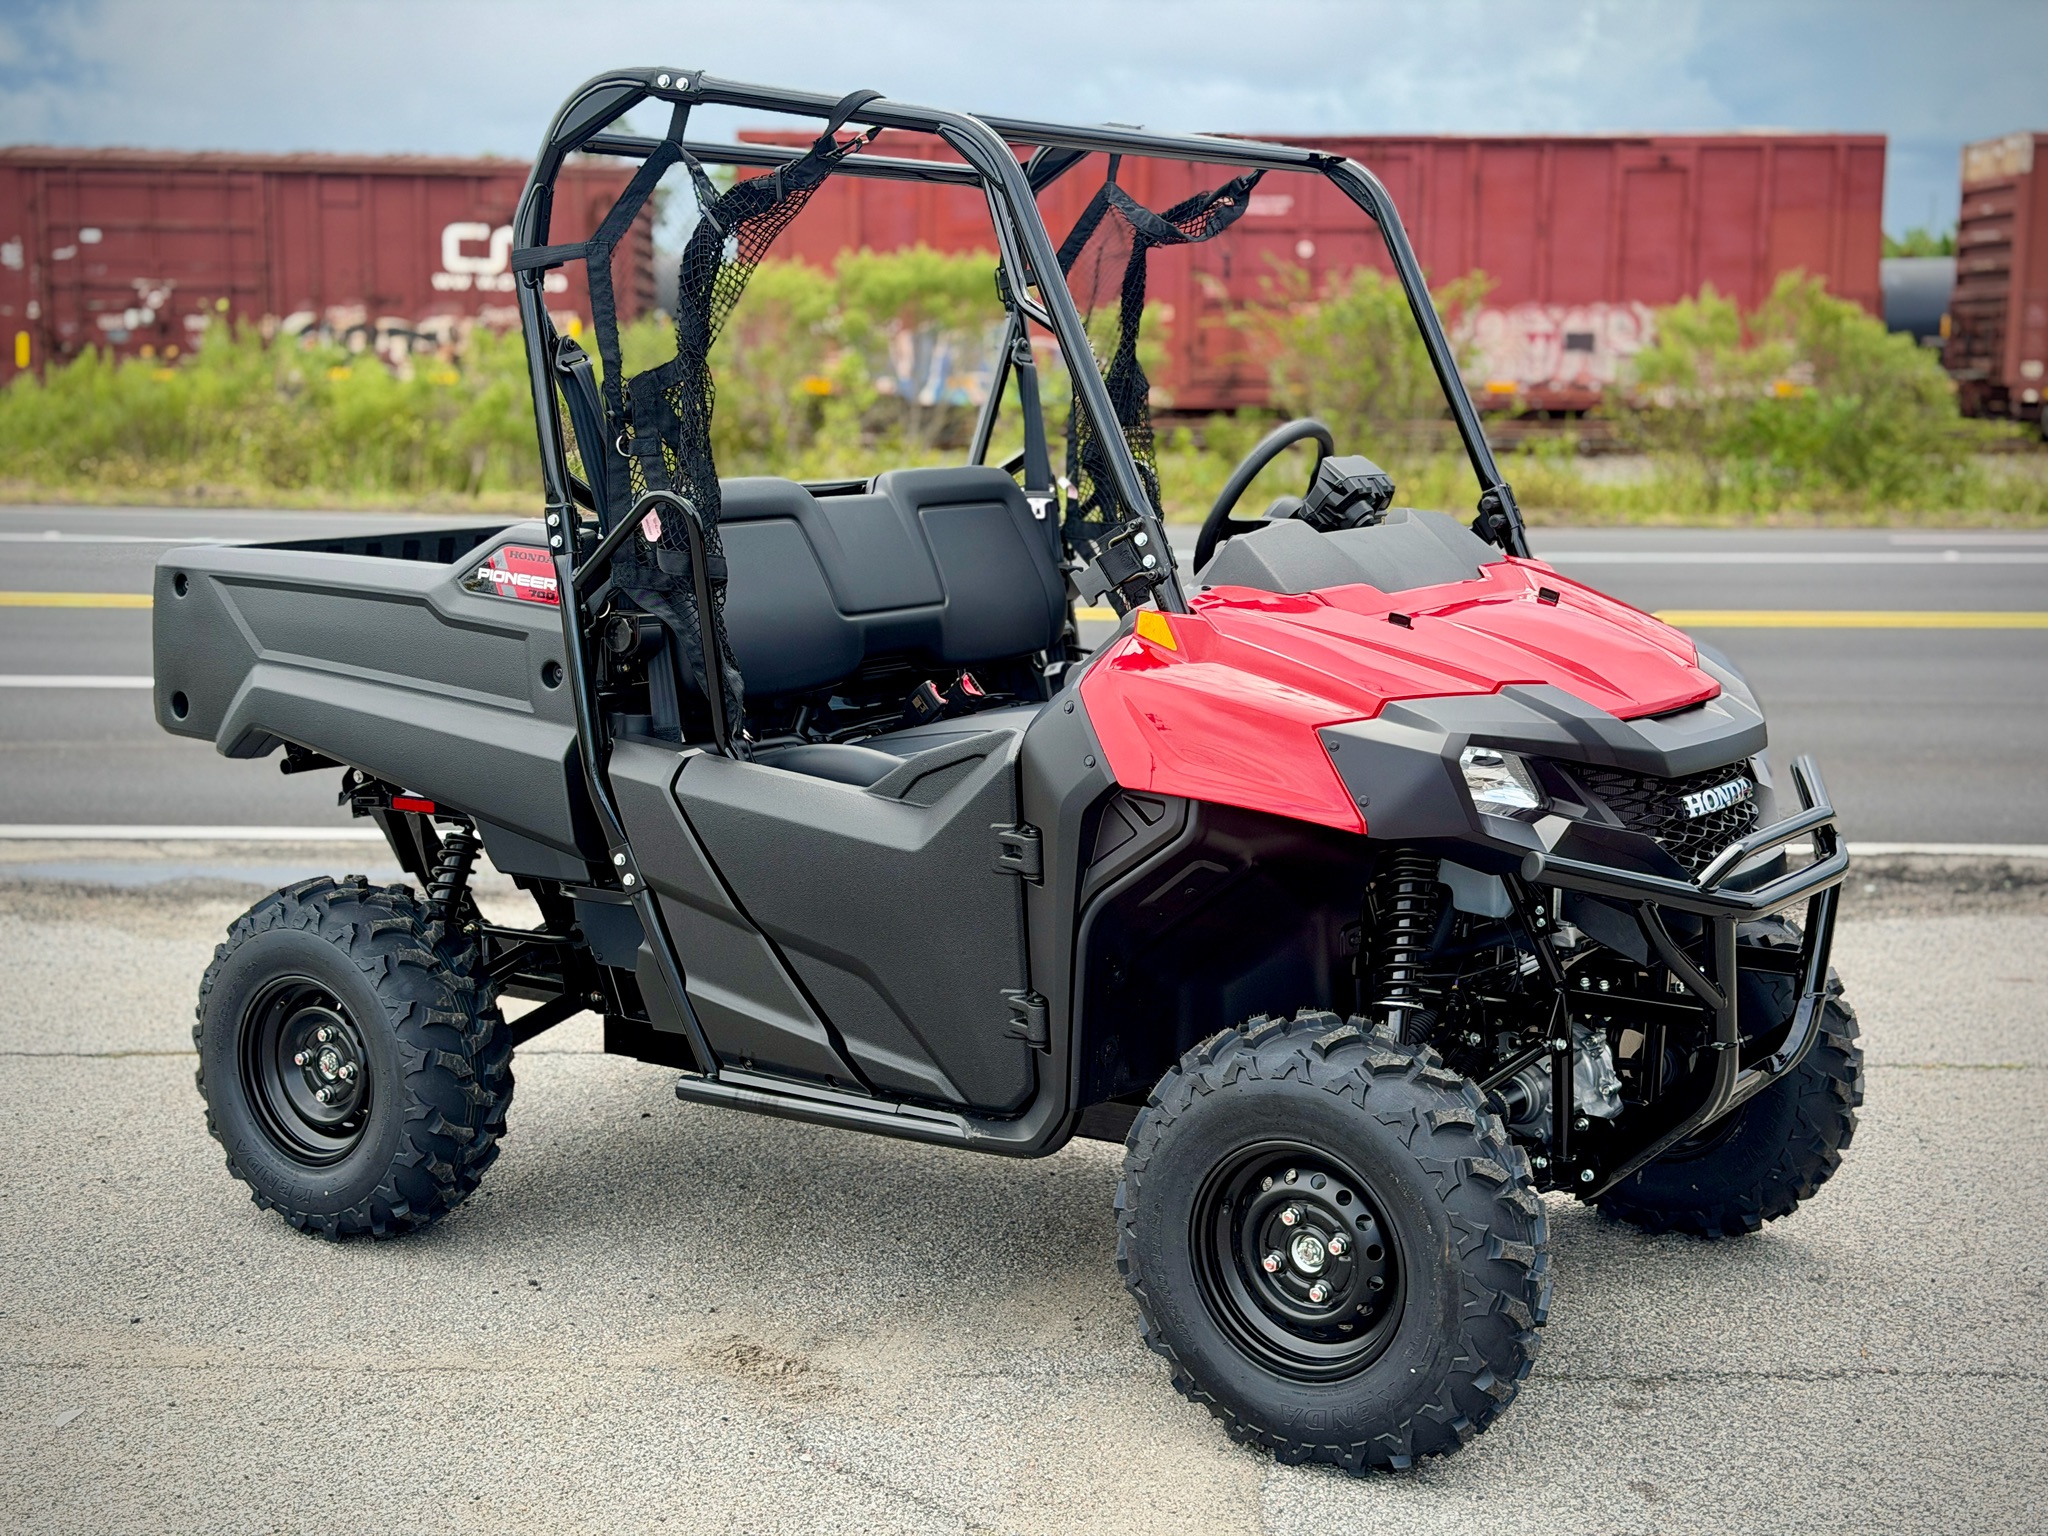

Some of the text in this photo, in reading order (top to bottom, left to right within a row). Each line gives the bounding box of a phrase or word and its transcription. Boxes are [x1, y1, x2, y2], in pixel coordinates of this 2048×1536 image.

[477, 567, 558, 591] PIONEER
[528, 589, 555, 600] 700
[1682, 778, 1753, 819] HONDA
[235, 1139, 313, 1204] KENDA
[1281, 1381, 1401, 1431] KENDA
